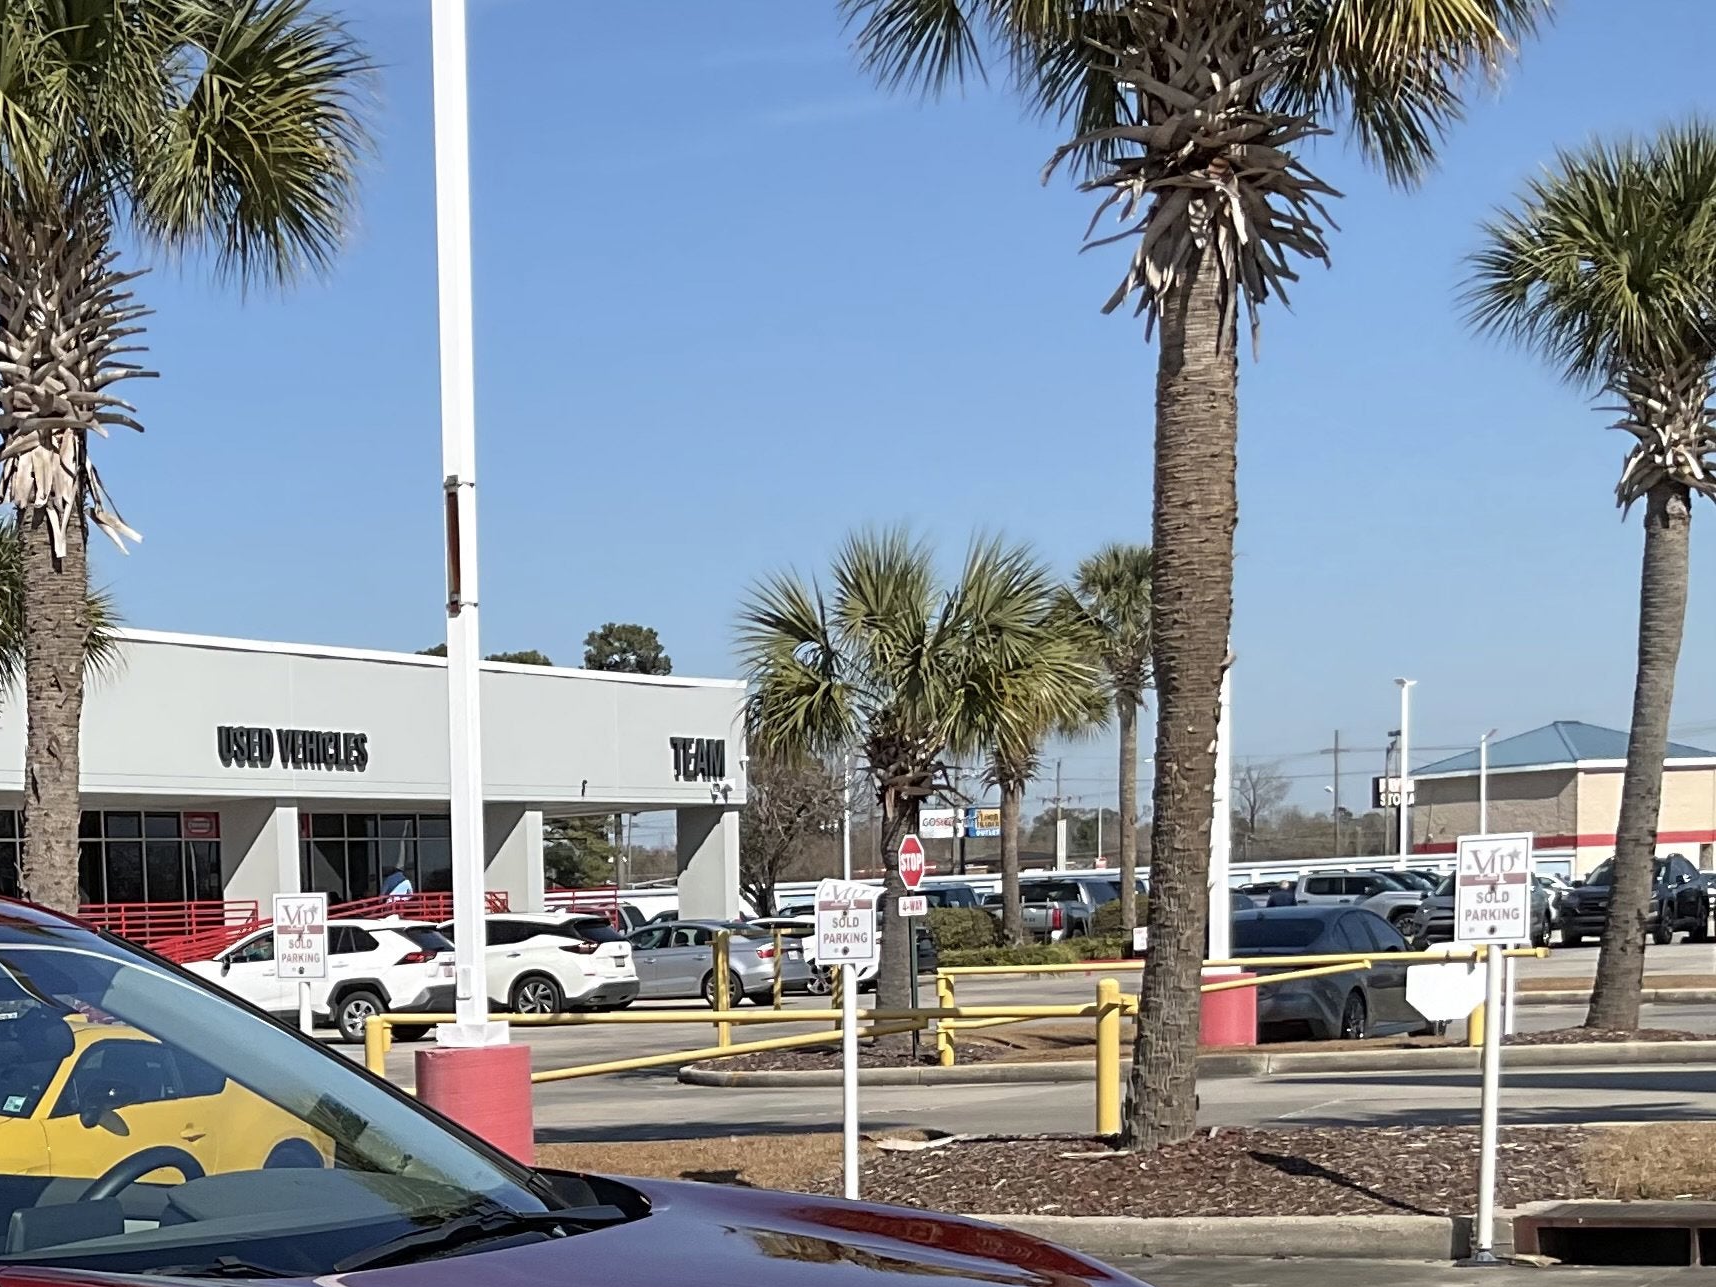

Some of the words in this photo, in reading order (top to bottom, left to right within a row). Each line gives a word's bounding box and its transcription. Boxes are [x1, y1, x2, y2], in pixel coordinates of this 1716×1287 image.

[217, 726, 274, 768] USED
[276, 729, 368, 772] VEHICLES
[669, 737, 725, 782] TEAM
[900, 852, 922, 872] STOP
[1476, 891, 1510, 904] SOLD
[902, 900, 923, 912] 4-WAY
[1465, 908, 1520, 921] PARKING
[832, 917, 860, 928] SOLD
[288, 939, 313, 949] SOLD
[823, 932, 868, 944] PARKING
[282, 953, 321, 963] PARKING
